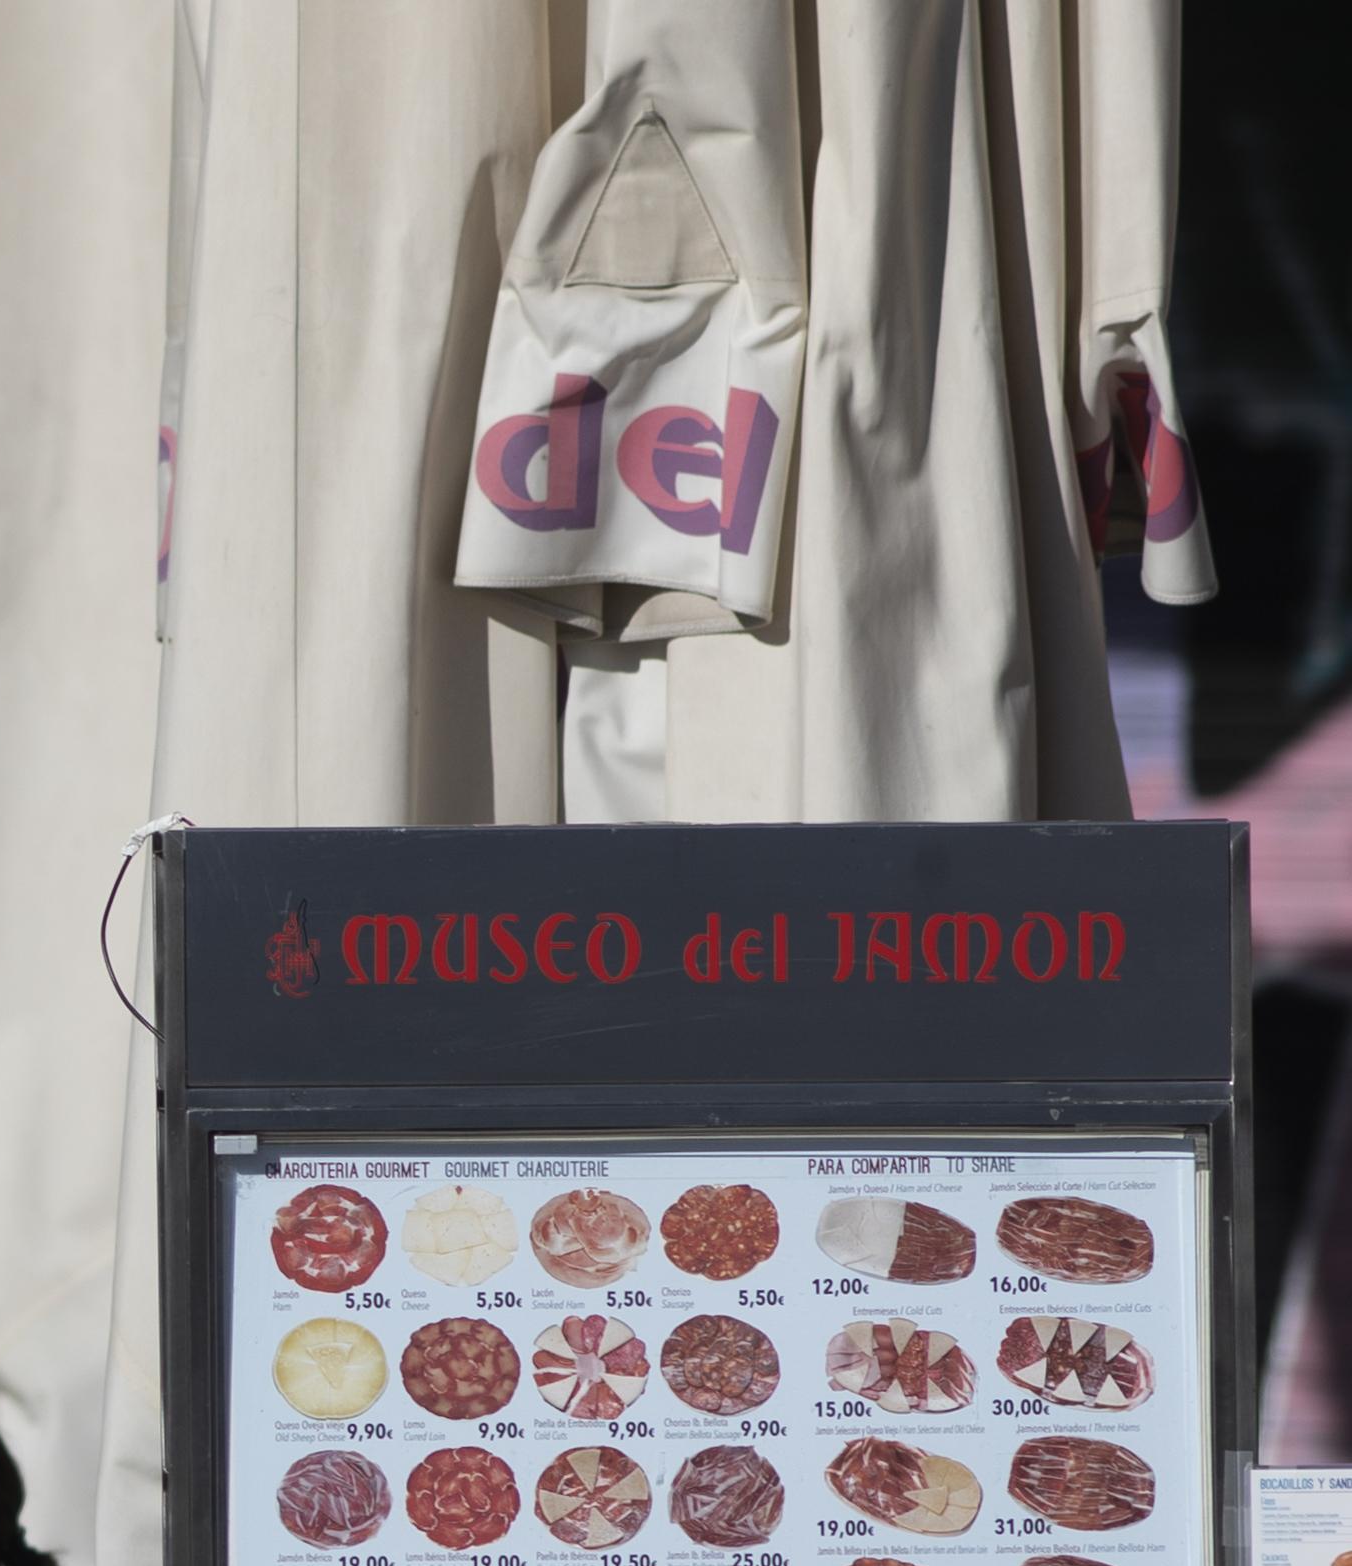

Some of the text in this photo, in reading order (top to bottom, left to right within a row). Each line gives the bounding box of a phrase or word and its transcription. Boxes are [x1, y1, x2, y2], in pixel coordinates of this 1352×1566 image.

[475, 373, 780, 556] del
[340, 910, 1128, 985] MUSEO del JAMON
[265, 1160, 609, 1178] CHARCUTERIA GOURMET GOURMET CHARCUTERIE
[808, 1156, 1015, 1175] PARA COMPARTIR TO SHARE
[828, 1185, 855, 1194] Jamón
[863, 1185, 889, 1193] Queso
[934, 1184, 962, 1193] Cheese
[531, 1289, 554, 1297] Lacón
[661, 1287, 691, 1296] Chorizo
[812, 1278, 869, 1295] 12,00€
[990, 1276, 1047, 1293] 16,00€
[272, 1291, 299, 1299] Jamón
[345, 1292, 390, 1310] 5,50€
[401, 1290, 427, 1298] Queso
[476, 1291, 523, 1310] 5,50€
[606, 1290, 652, 1308] 5,50€
[738, 1289, 784, 1307] 5,50€
[402, 1302, 430, 1310] Cheese
[531, 1300, 564, 1309] Smoked
[661, 1300, 695, 1309] Sausage
[815, 1401, 872, 1418] 15,00€
[992, 1399, 1049, 1416] 30,00€
[347, 1423, 393, 1441] 9,90€
[404, 1421, 425, 1429] Lomo
[478, 1422, 524, 1440] 9,90€
[609, 1421, 655, 1440] 9,90€
[741, 1420, 787, 1438] 9,90€
[817, 1520, 874, 1537] 19,00€
[995, 1518, 1052, 1535] 31,00€
